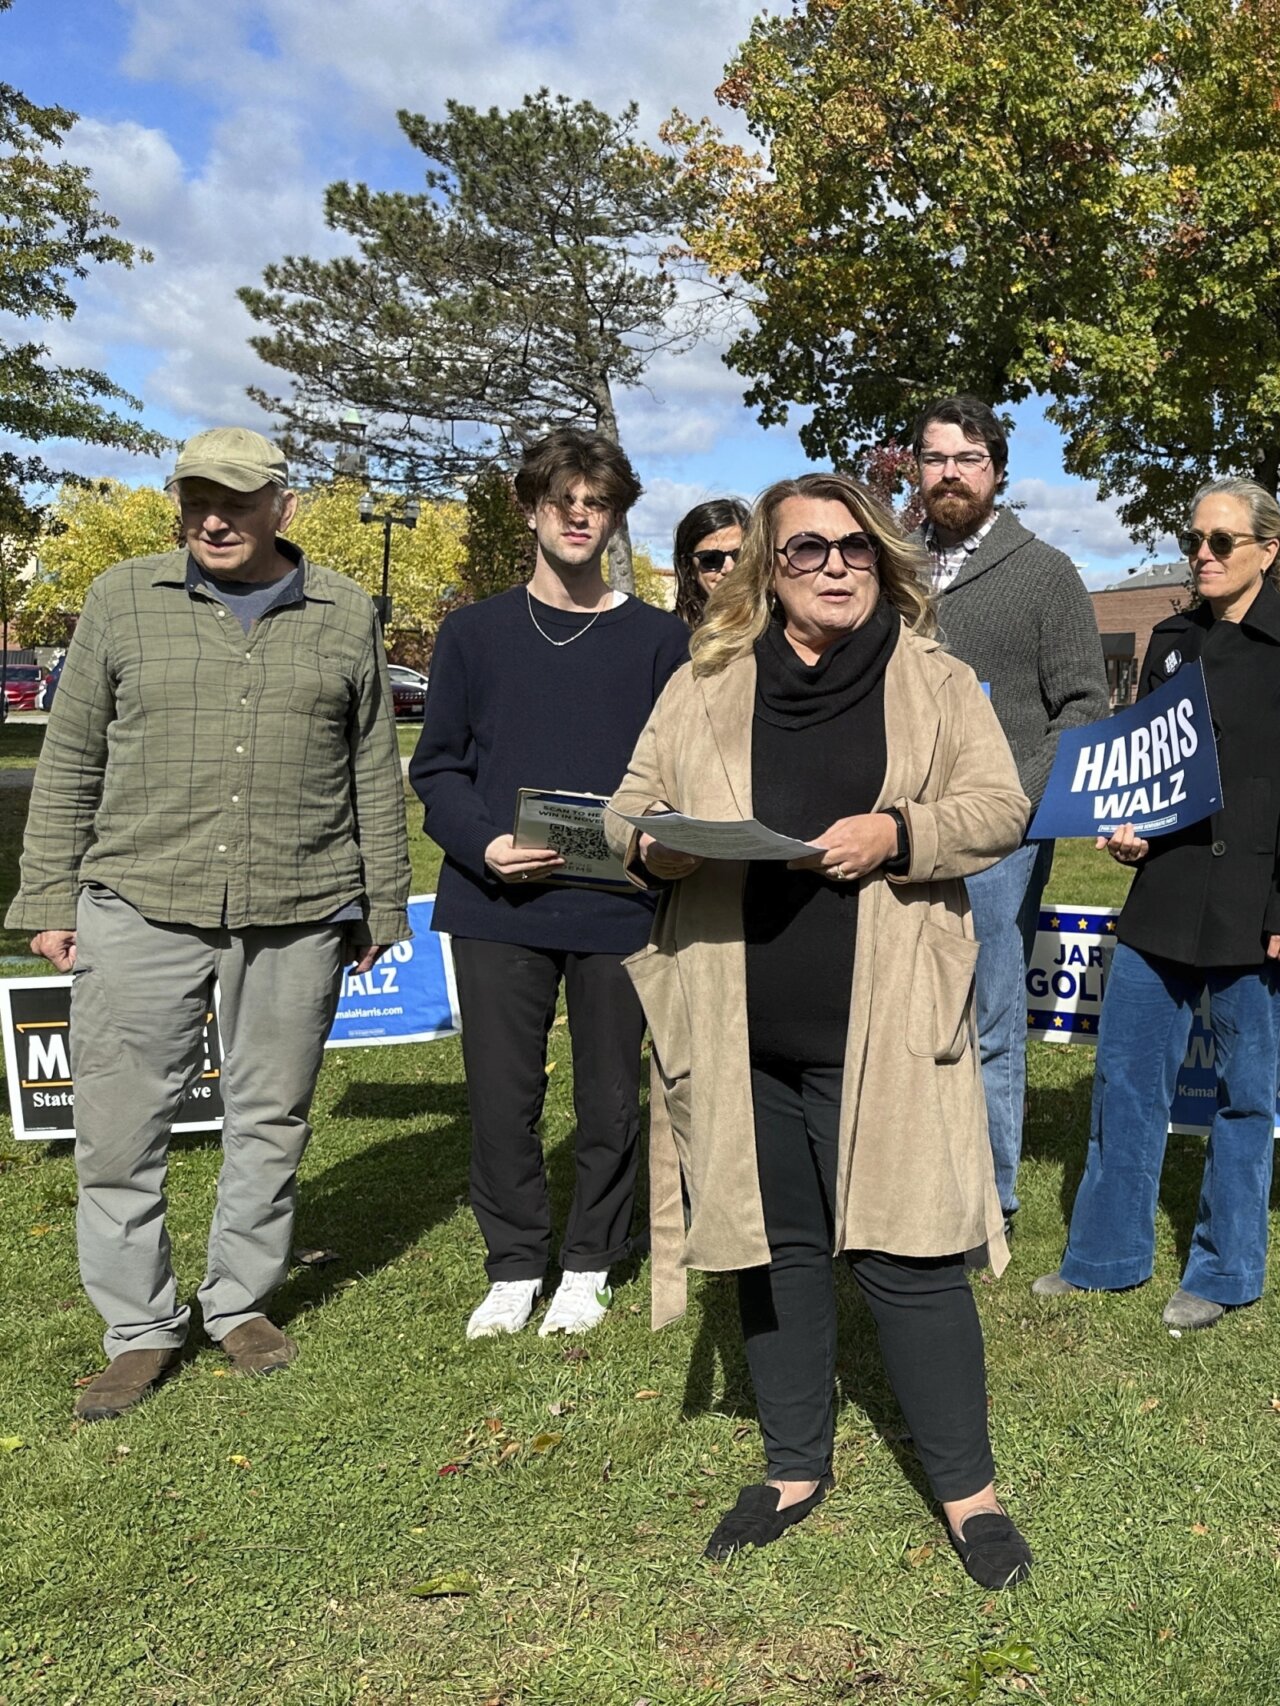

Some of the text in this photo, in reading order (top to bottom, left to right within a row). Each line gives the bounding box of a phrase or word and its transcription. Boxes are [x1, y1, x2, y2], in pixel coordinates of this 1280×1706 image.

[1071, 698, 1198, 792] HARRIS
[1093, 769, 1187, 819] WALZ
[539, 810, 559, 818] WIN
[574, 815, 604, 824] NOVE
[543, 805, 570, 814] SCAN
[1053, 944, 1104, 968] JAR
[340, 967, 399, 998] ALZ
[1026, 968, 1105, 1002] GOL
[335, 1006, 403, 1019] malaHarris.com
